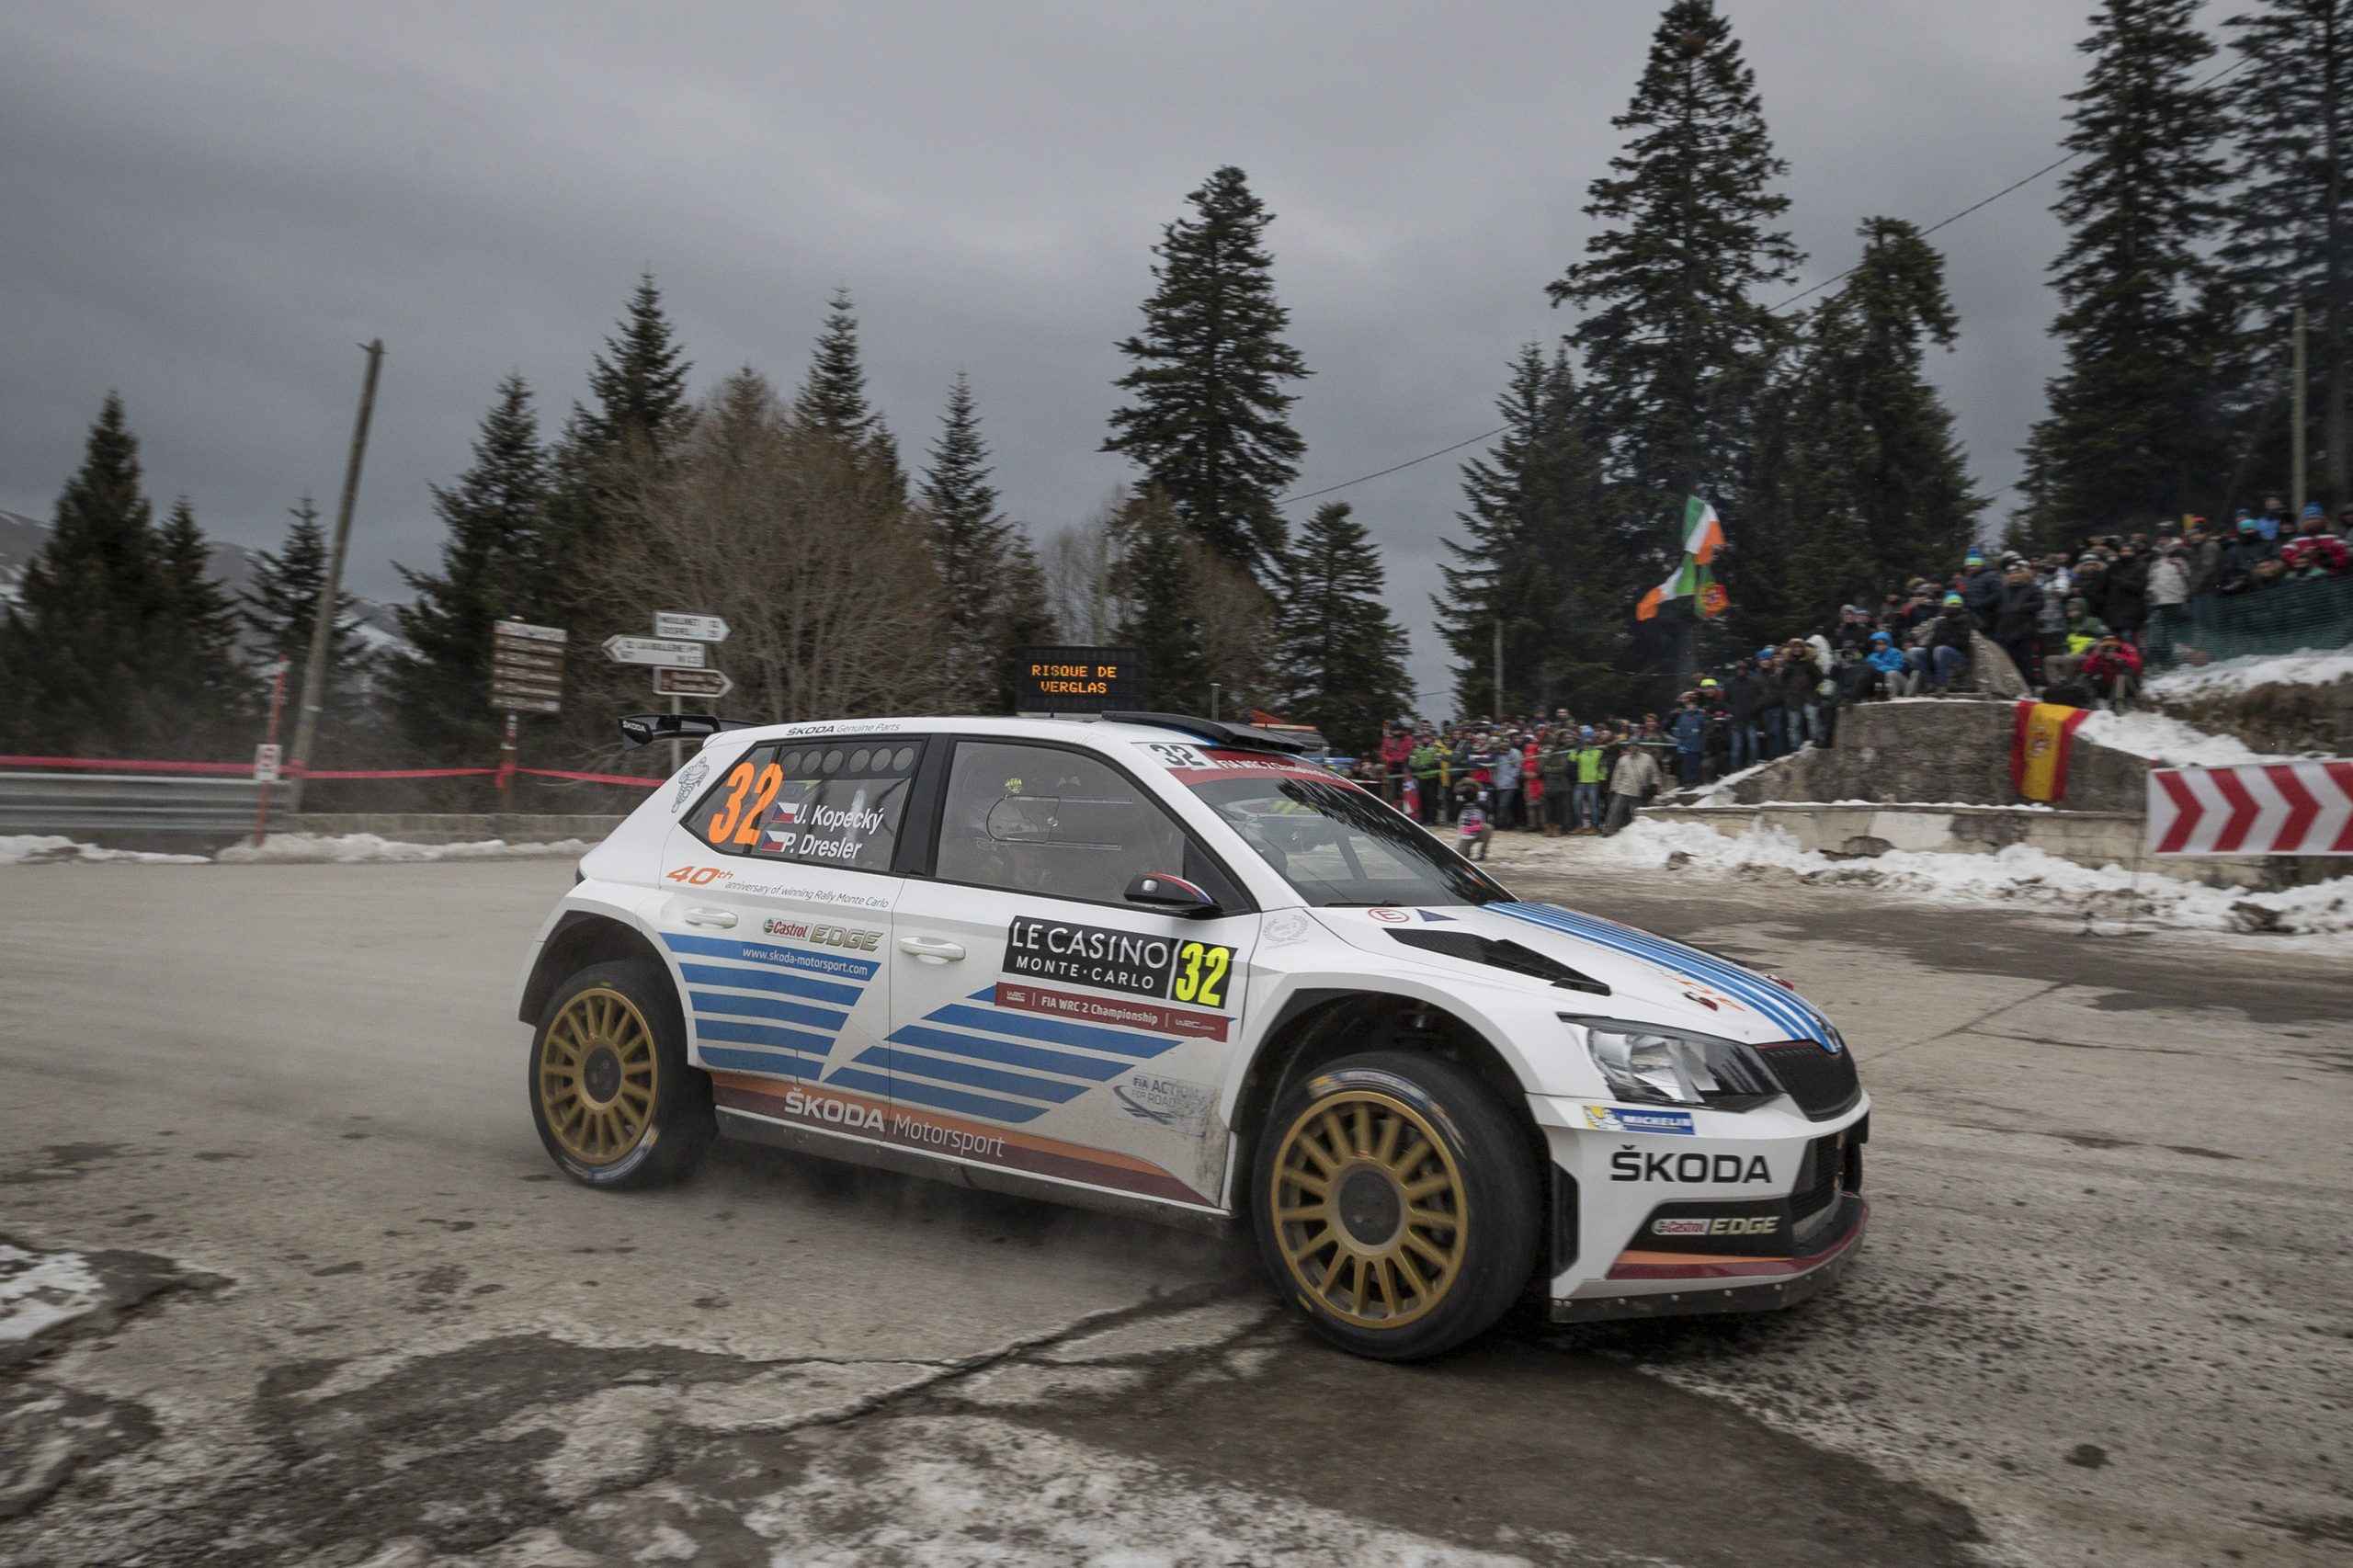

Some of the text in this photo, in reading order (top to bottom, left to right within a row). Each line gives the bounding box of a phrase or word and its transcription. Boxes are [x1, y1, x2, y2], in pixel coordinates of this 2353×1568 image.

[1030, 665, 1118, 678] RISQUE DE
[1040, 681, 1108, 694] VERGLAS
[786, 722, 902, 736] ŠKODA Genuine Parts
[1149, 744, 1206, 767] 32
[709, 762, 783, 846] 32
[793, 804, 884, 835] J. Kopecký
[781, 834, 863, 860] P. Dresler
[665, 866, 733, 886] 40th
[724, 881, 889, 908] anniversary of winning Rally Monte Carlo
[772, 921, 883, 952] Castrol EDGE
[1012, 922, 1169, 969] LE CASINO
[742, 947, 868, 976] www.skoda-motorsport.com
[1175, 942, 1230, 1006] 32
[1041, 996, 1159, 1027] FIA WRC 2 Championship
[783, 1087, 1006, 1157] ŠKODA Motorsport
[1621, 1114, 1692, 1127] MICHELIN
[1610, 1144, 1772, 1184] ŠKODA
[1710, 1217, 1779, 1235] EDGE
